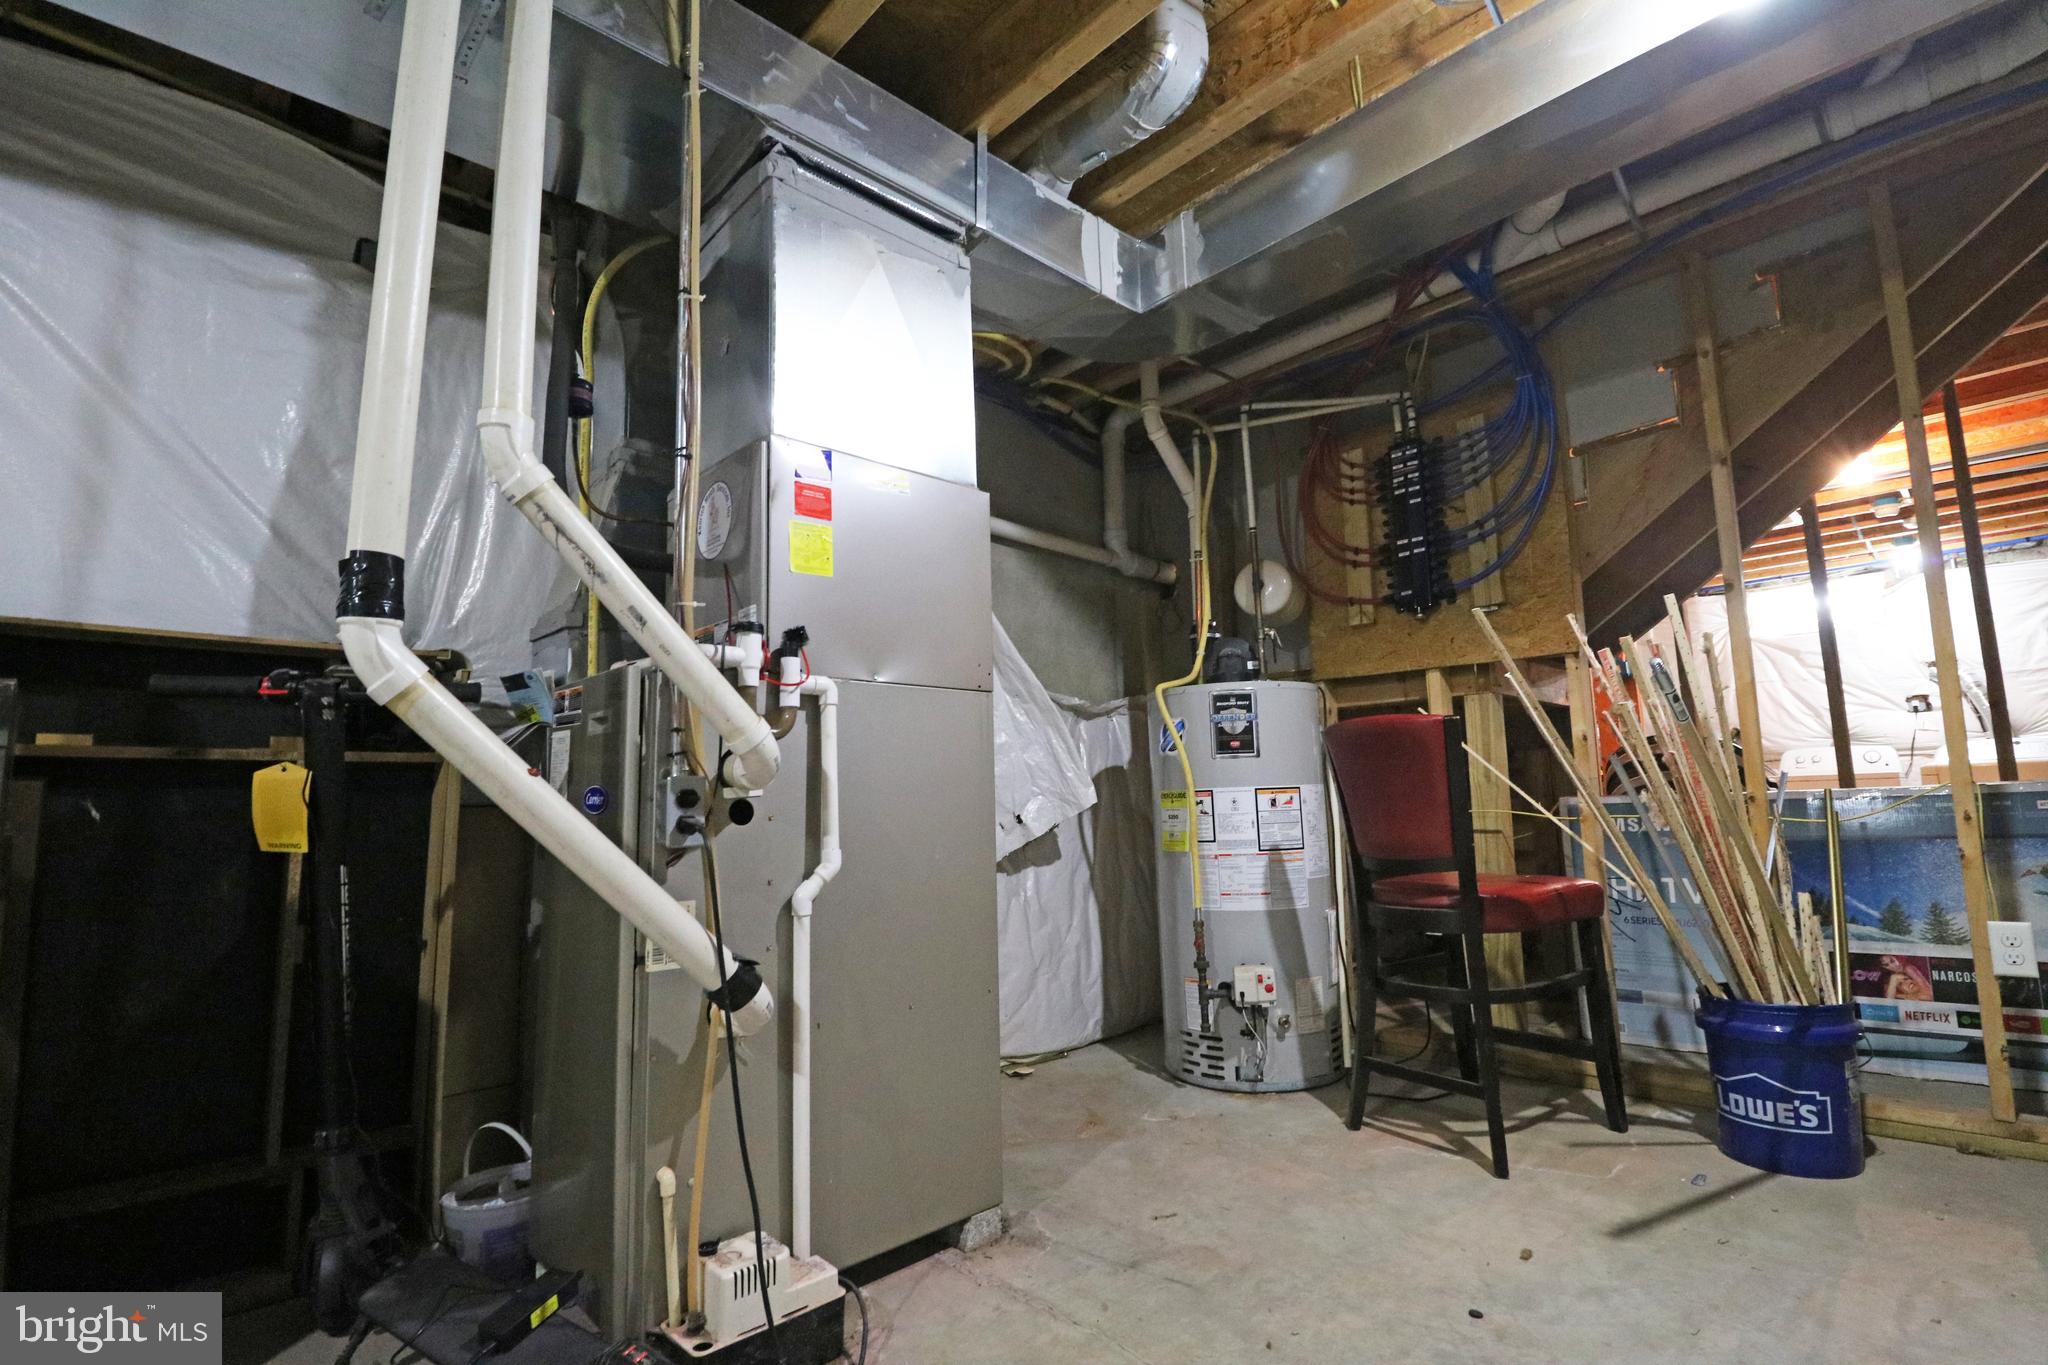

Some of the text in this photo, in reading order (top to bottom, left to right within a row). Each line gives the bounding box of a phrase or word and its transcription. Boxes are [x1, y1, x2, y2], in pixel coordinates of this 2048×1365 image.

[585, 793, 604, 805] Carrier
[267, 841, 302, 850] WARNING
[1932, 970, 1977, 983] NARCOS
[1904, 1010, 1951, 1024] NETFLIX
[1718, 1087, 1819, 1128] LOWE'S
